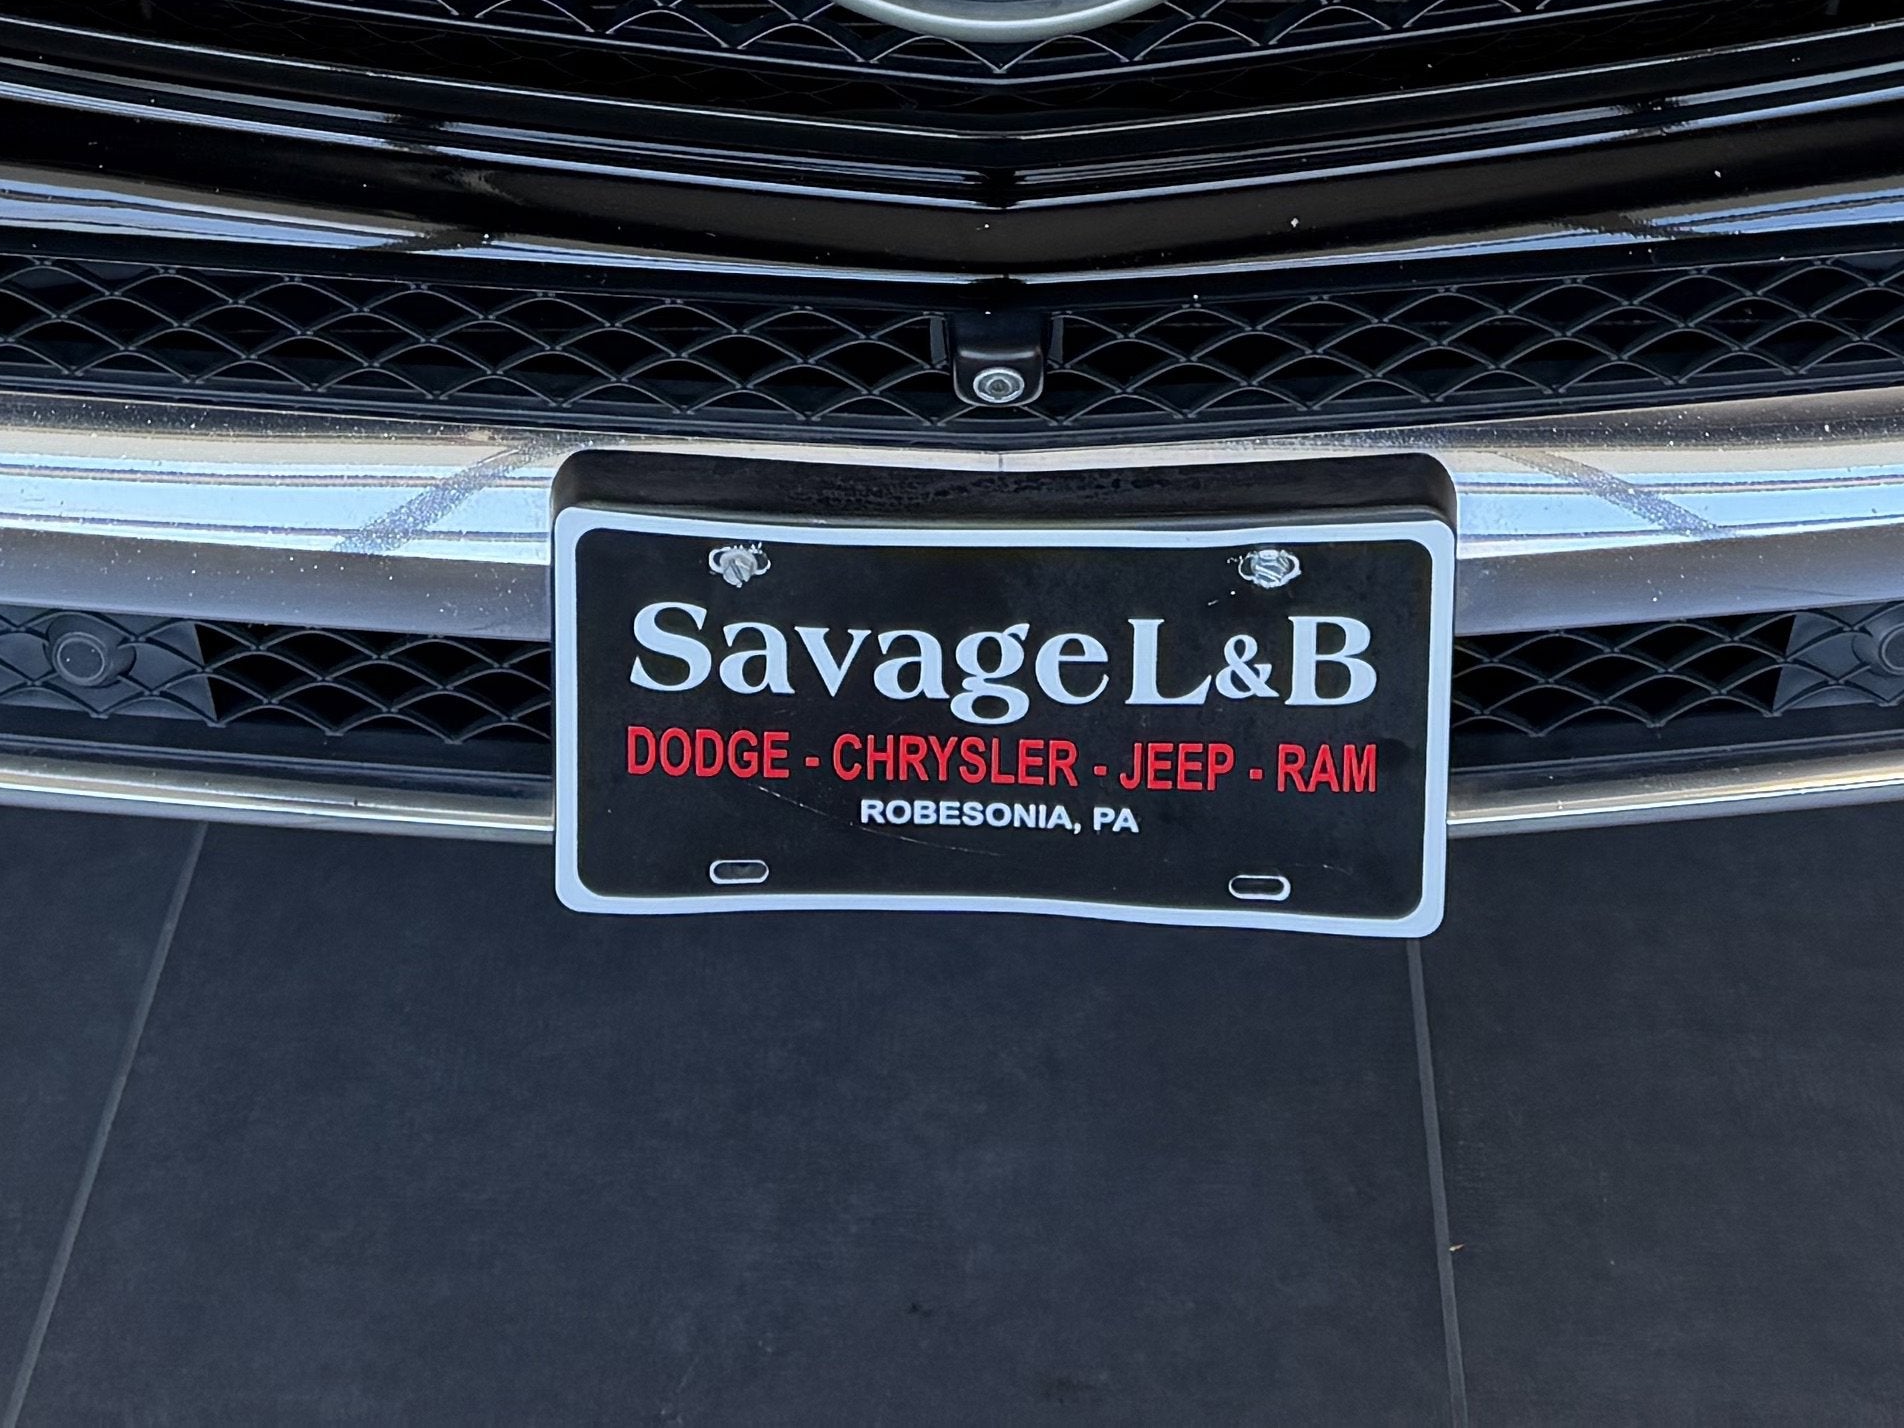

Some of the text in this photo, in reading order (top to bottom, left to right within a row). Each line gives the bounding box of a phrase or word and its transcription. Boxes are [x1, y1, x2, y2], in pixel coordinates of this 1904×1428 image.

[629, 600, 1378, 725] Savage L&B
[626, 725, 791, 779] DODGE
[832, 732, 1079, 788] CHRYSLER
[1118, 741, 1235, 792] JEEP
[1276, 743, 1378, 793] RAM
[860, 799, 1140, 835] ROBESONIA, PA
